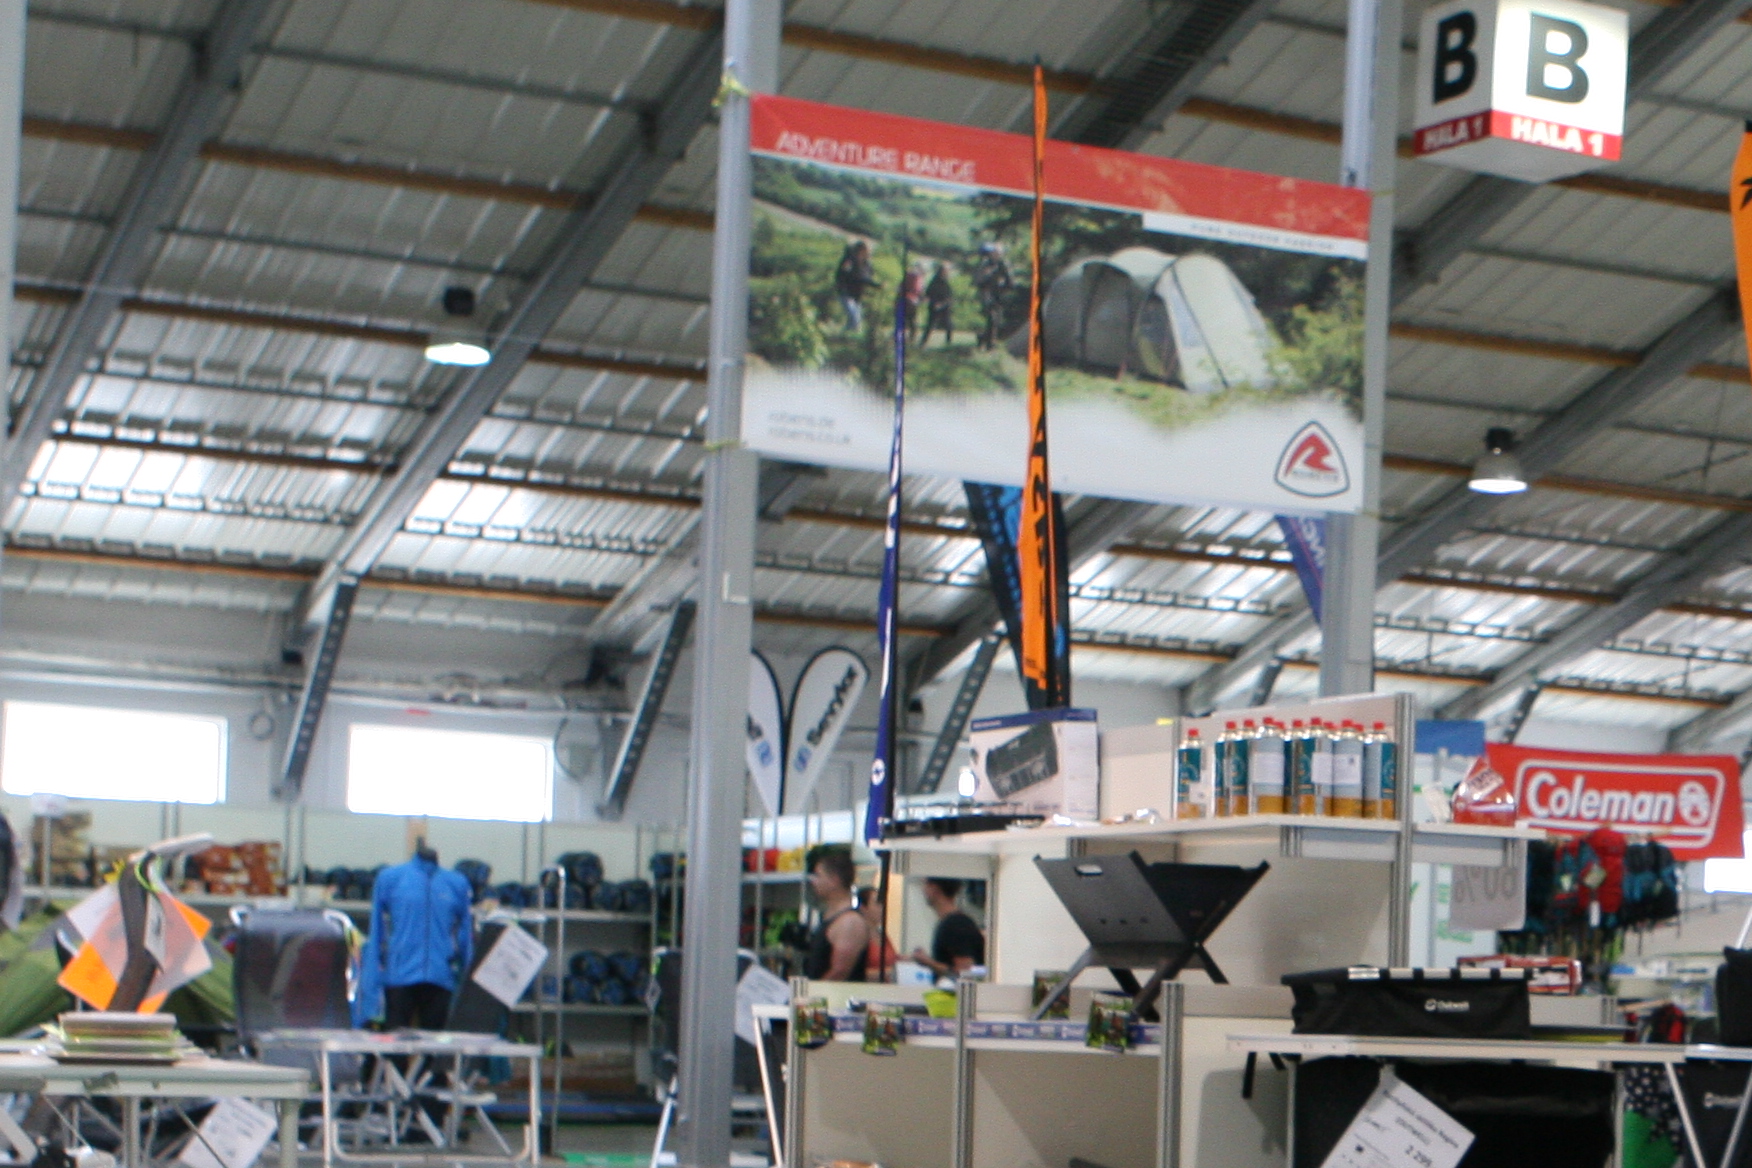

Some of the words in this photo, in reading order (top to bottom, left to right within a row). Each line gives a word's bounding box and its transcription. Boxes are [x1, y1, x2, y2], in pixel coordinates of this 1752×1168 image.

[1433, 10, 1478, 104] B
[1526, 11, 1589, 104] B
[775, 130, 900, 172] ADVENTURE
[903, 150, 977, 184] RANGE
[1422, 120, 1469, 151] HALA
[1473, 115, 1485, 133] 1
[1511, 116, 1584, 152] HALA
[1588, 132, 1605, 156] 1
[1526, 771, 1677, 824] Coleman
